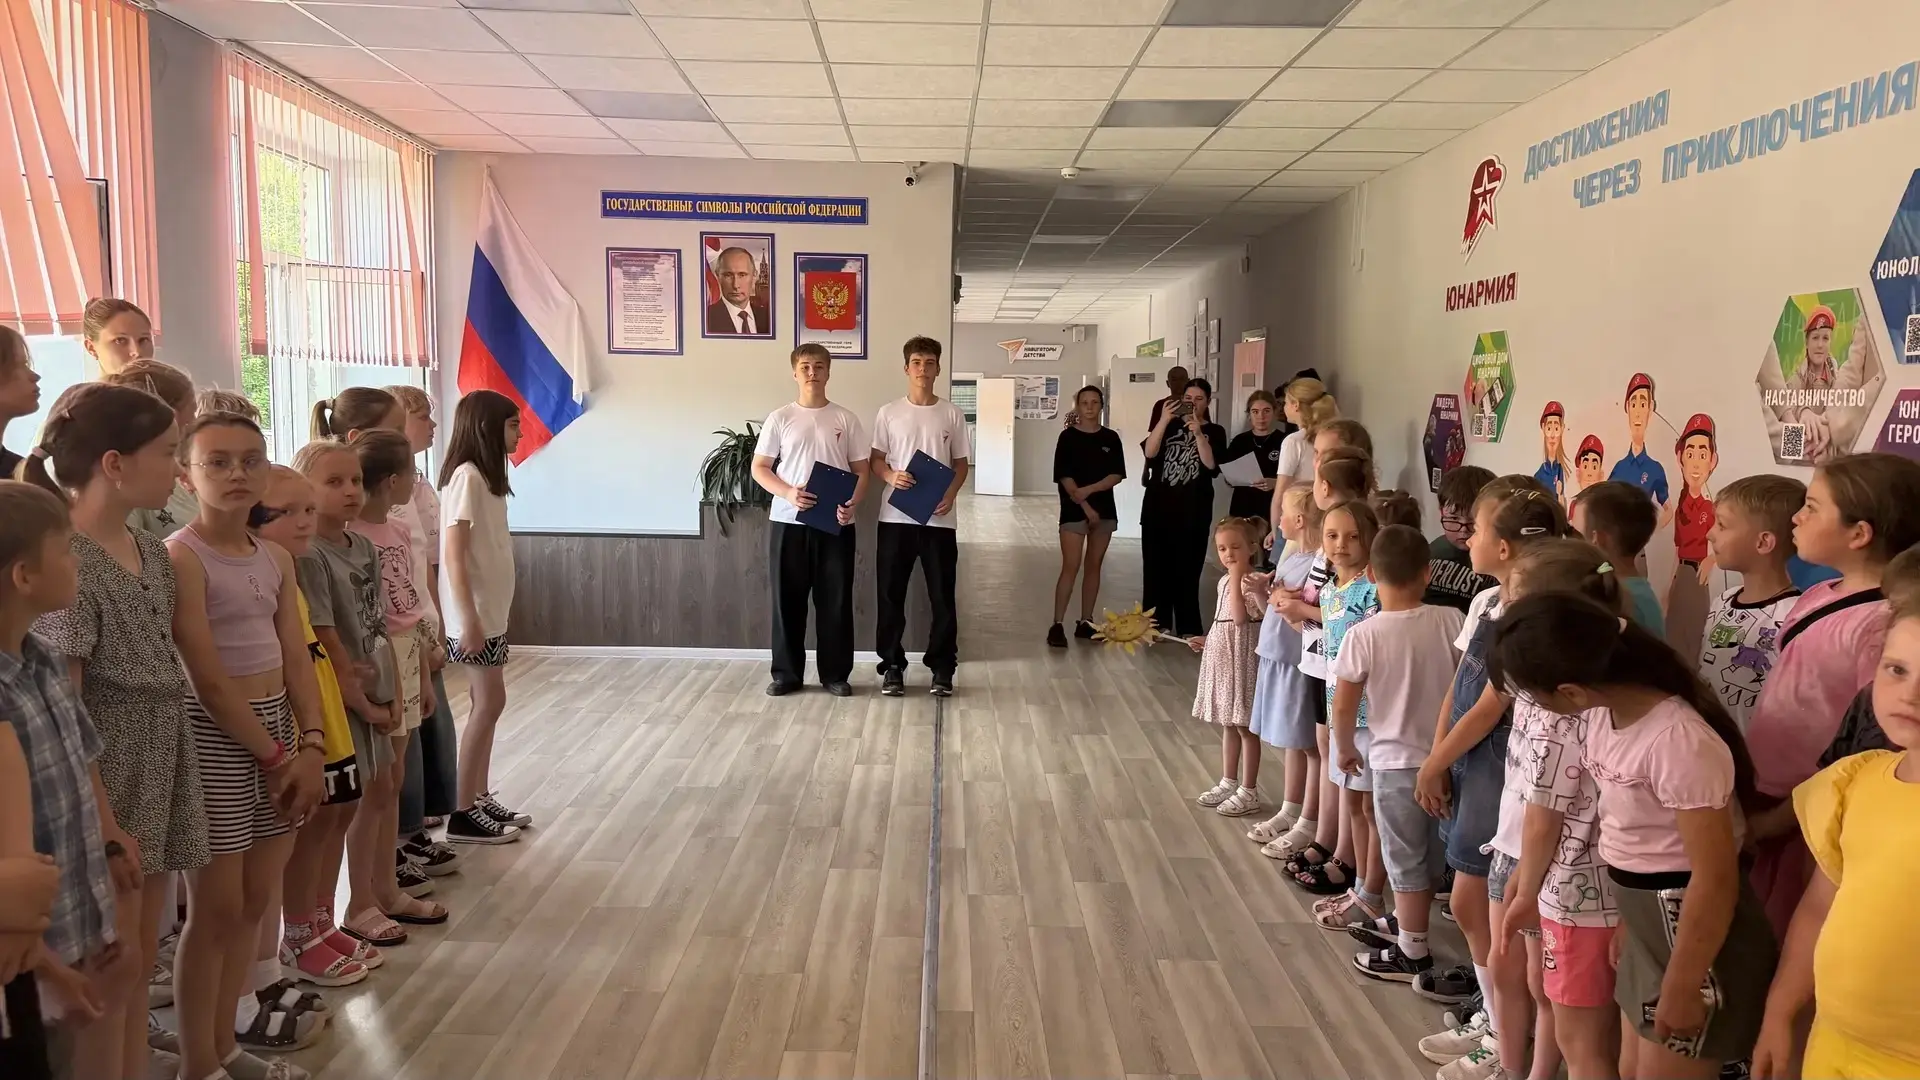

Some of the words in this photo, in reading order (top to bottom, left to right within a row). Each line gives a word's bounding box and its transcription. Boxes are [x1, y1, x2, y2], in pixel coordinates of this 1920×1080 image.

[1524, 89, 1670, 183] ДОСТИЖЕНИЯ
[1573, 159, 1641, 208] ЧЕРЕЗ
[1662, 60, 1919, 183] ПРИКЛЮЧЕНИЯ
[606, 197, 694, 213] ГОСУДАРСТВЕННЫЕ
[696, 200, 742, 214] СИМВОЛЫ
[745, 200, 806, 216] РОССИЙСКОЙ
[808, 203, 862, 218] ФЕДЕРАЦИИ
[1445, 272, 1518, 312] ЮНАРМИЯ
[1764, 388, 1866, 407] НАСТАВНИЧЕСТВО
[1888, 424, 1919, 444] ГЕРО
